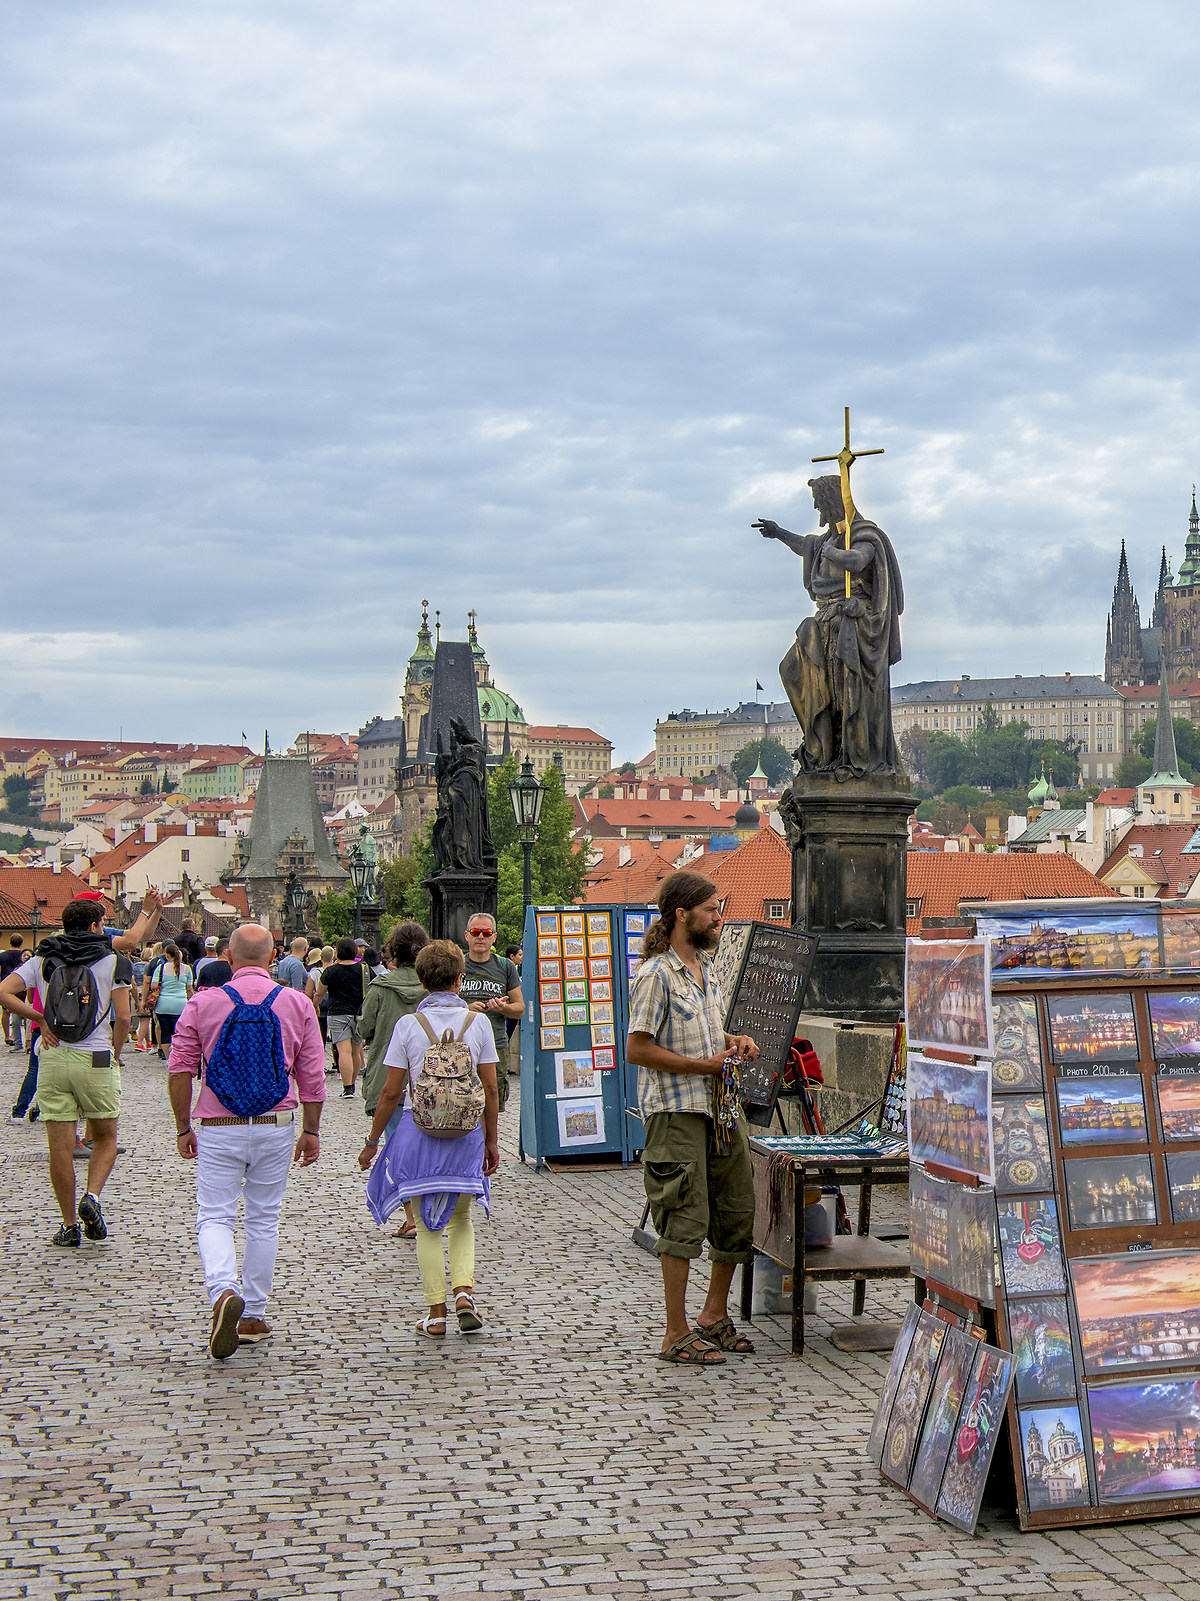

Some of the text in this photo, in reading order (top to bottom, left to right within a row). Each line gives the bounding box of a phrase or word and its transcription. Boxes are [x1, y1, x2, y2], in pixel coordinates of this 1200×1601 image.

[459, 979, 503, 994] HARD ROCK
[1060, 1065, 1064, 1077] 1
[1066, 1068, 1089, 1076] PHOTO
[1092, 1064, 1110, 1077] 200
[1159, 1063, 1167, 1075] 2
[1169, 1067, 1195, 1075] PHOTOS
